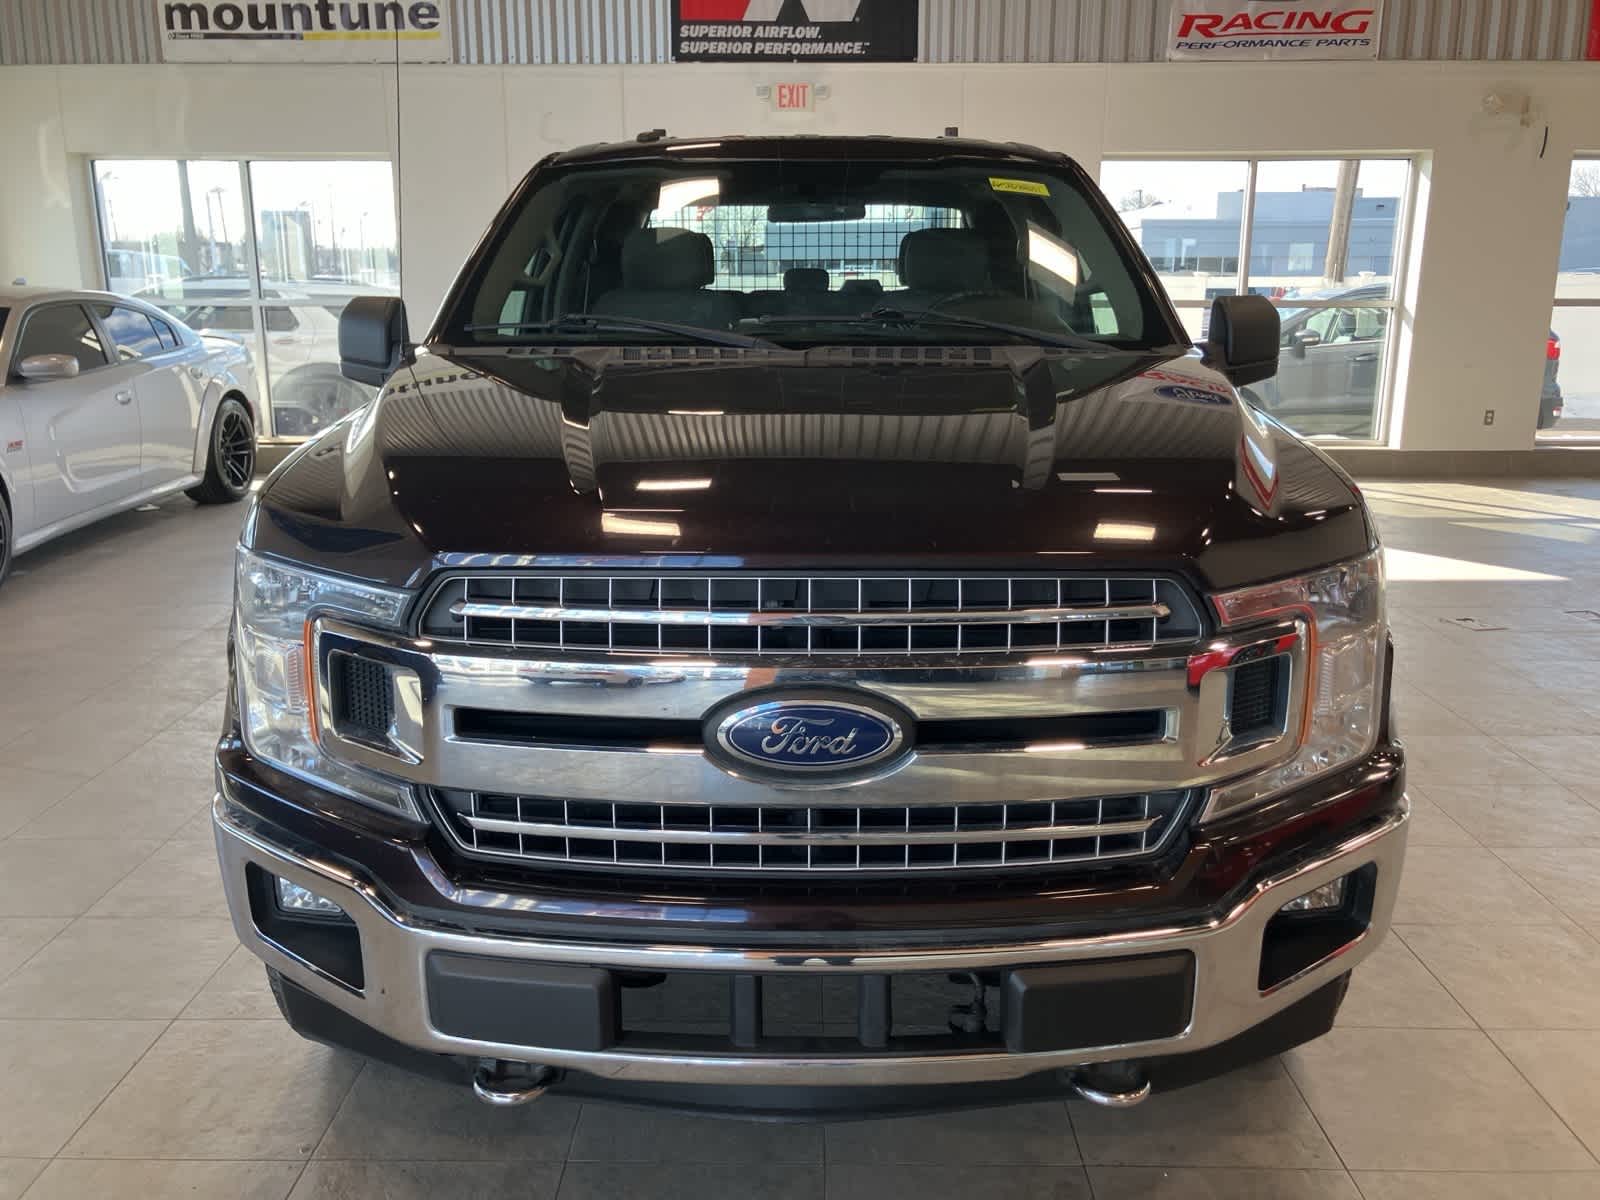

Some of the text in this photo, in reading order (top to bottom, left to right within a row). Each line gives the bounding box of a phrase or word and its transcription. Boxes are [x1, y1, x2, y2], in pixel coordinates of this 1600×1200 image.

[165, 0, 441, 31] mountune
[1177, 10, 1375, 38] RACING
[680, 25, 822, 39] SUPERIOR AIRFLOW.
[1176, 38, 1371, 50] PERFORMANCE PARTS
[680, 41, 752, 54] SUPERIOR
[777, 84, 809, 108] EXIT
[761, 715, 858, 755] Ford
